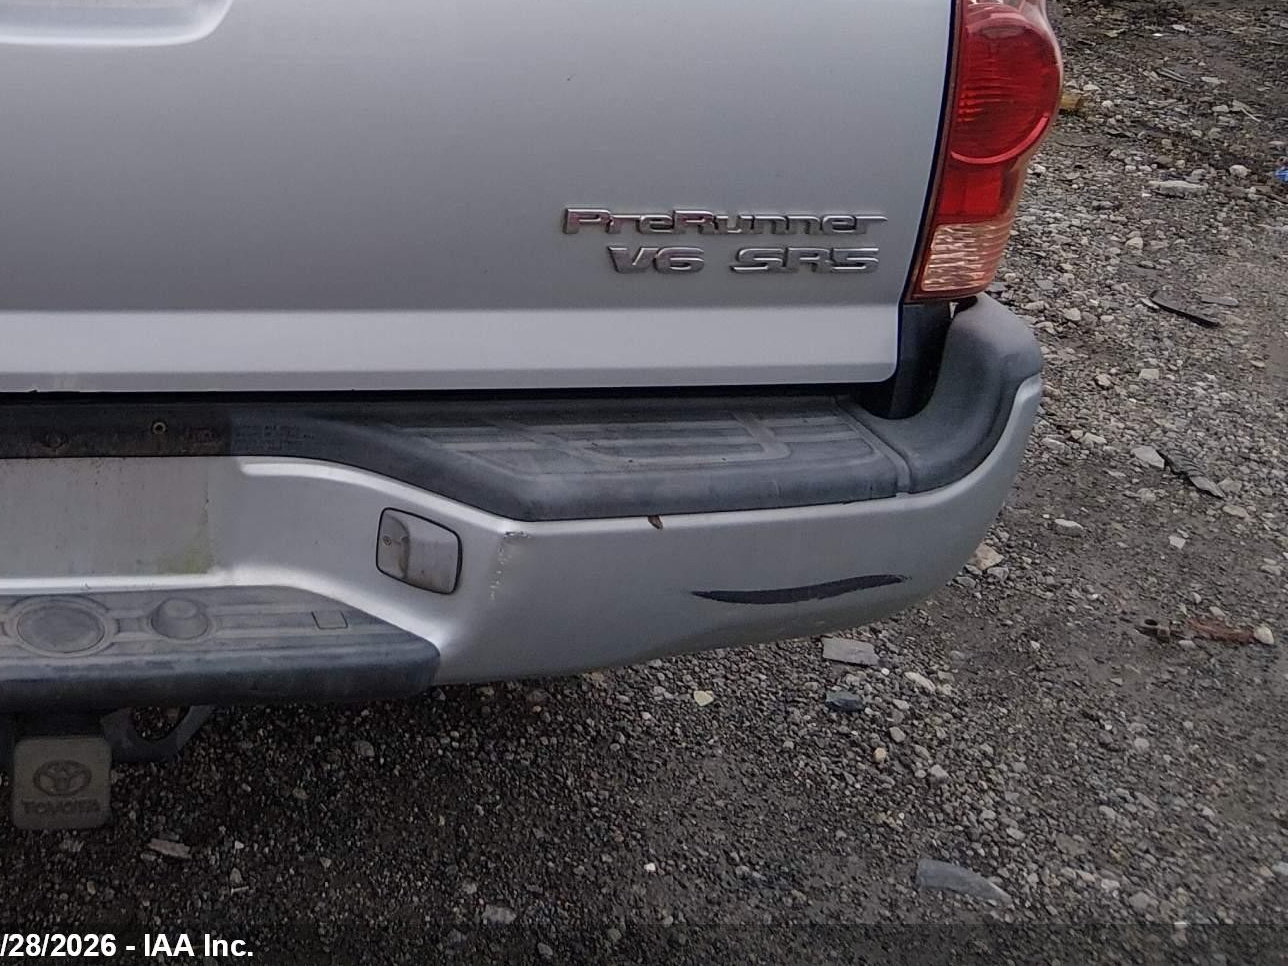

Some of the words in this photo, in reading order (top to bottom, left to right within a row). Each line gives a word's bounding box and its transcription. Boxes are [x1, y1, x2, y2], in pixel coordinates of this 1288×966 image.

[562, 208, 888, 235] PreRunner
[608, 245, 705, 273] V6
[730, 246, 880, 274] SR5
